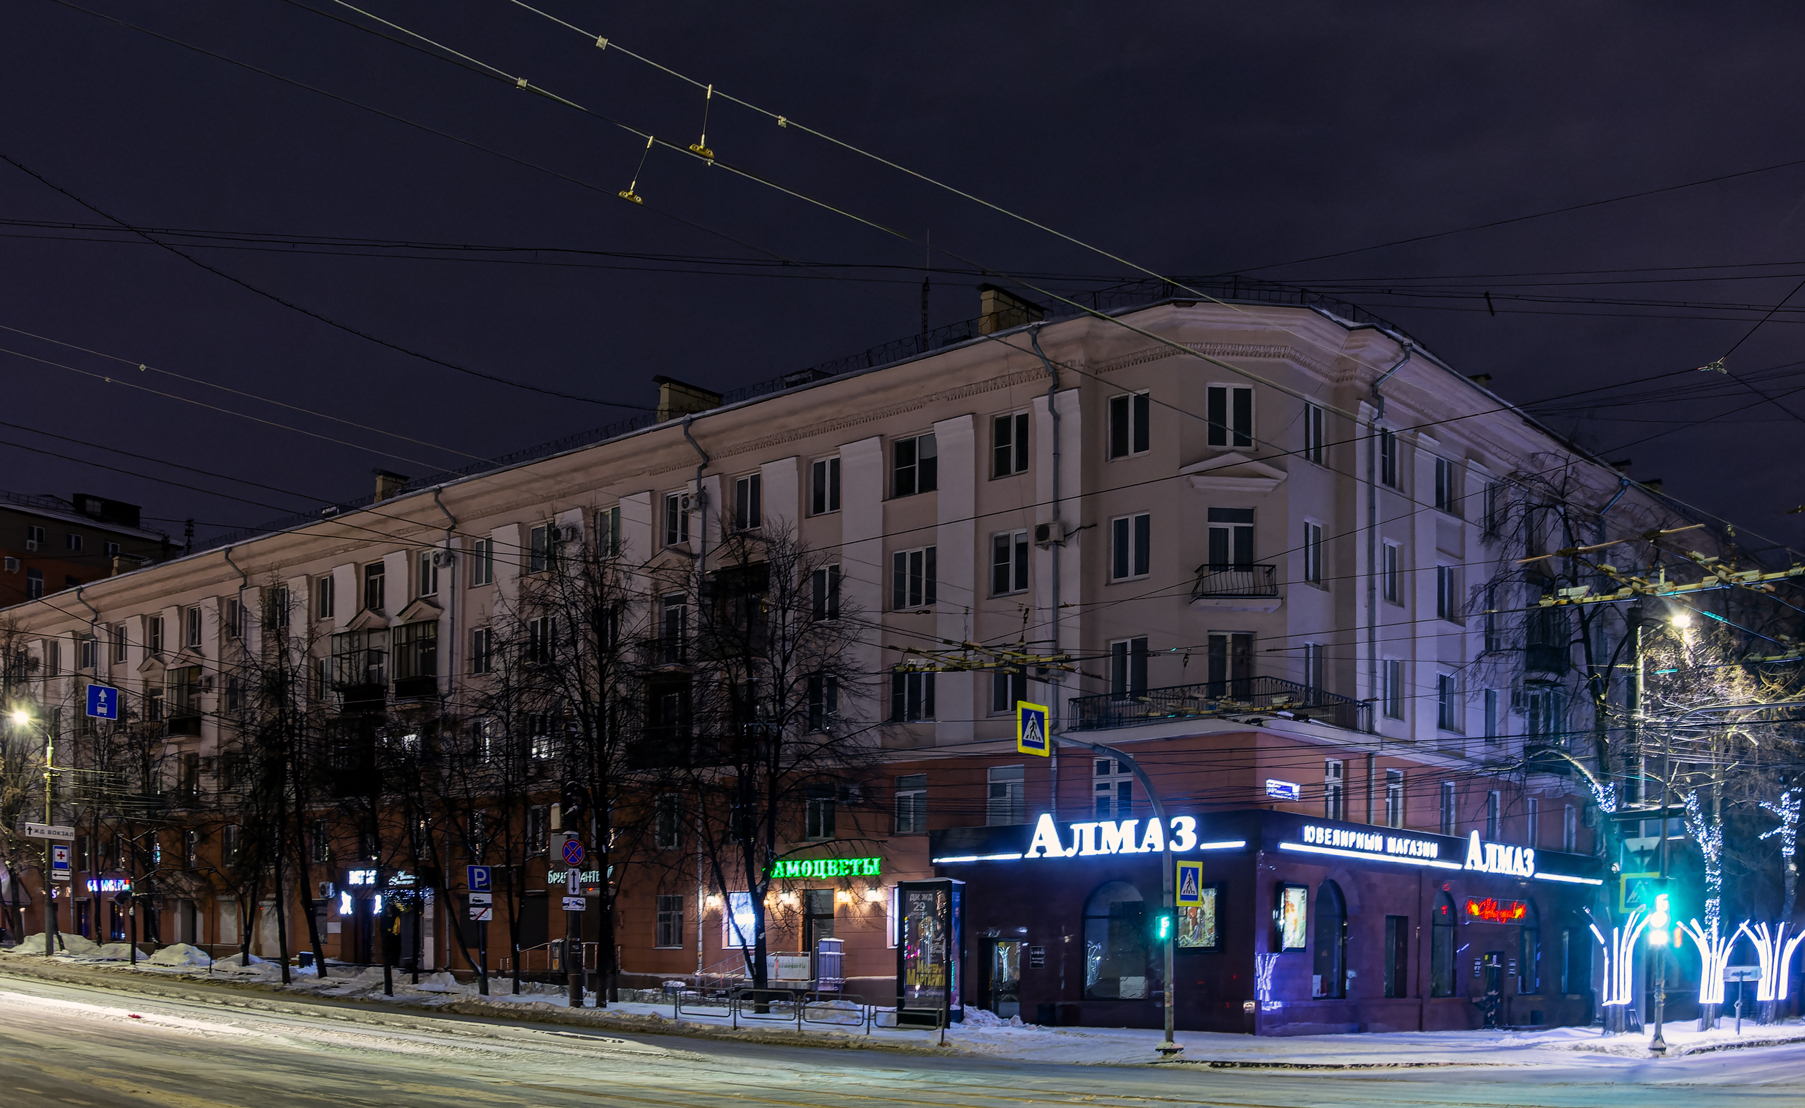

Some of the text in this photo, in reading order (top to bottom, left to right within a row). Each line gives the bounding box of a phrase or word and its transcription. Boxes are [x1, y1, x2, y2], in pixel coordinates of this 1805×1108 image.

[47, 829, 74, 837] ВОКЗАЛ
[1387, 836, 1438, 858] МАГАЗИН
[769, 857, 881, 879] АМОЦВЕТЫ
[912, 901, 926, 912] 29
